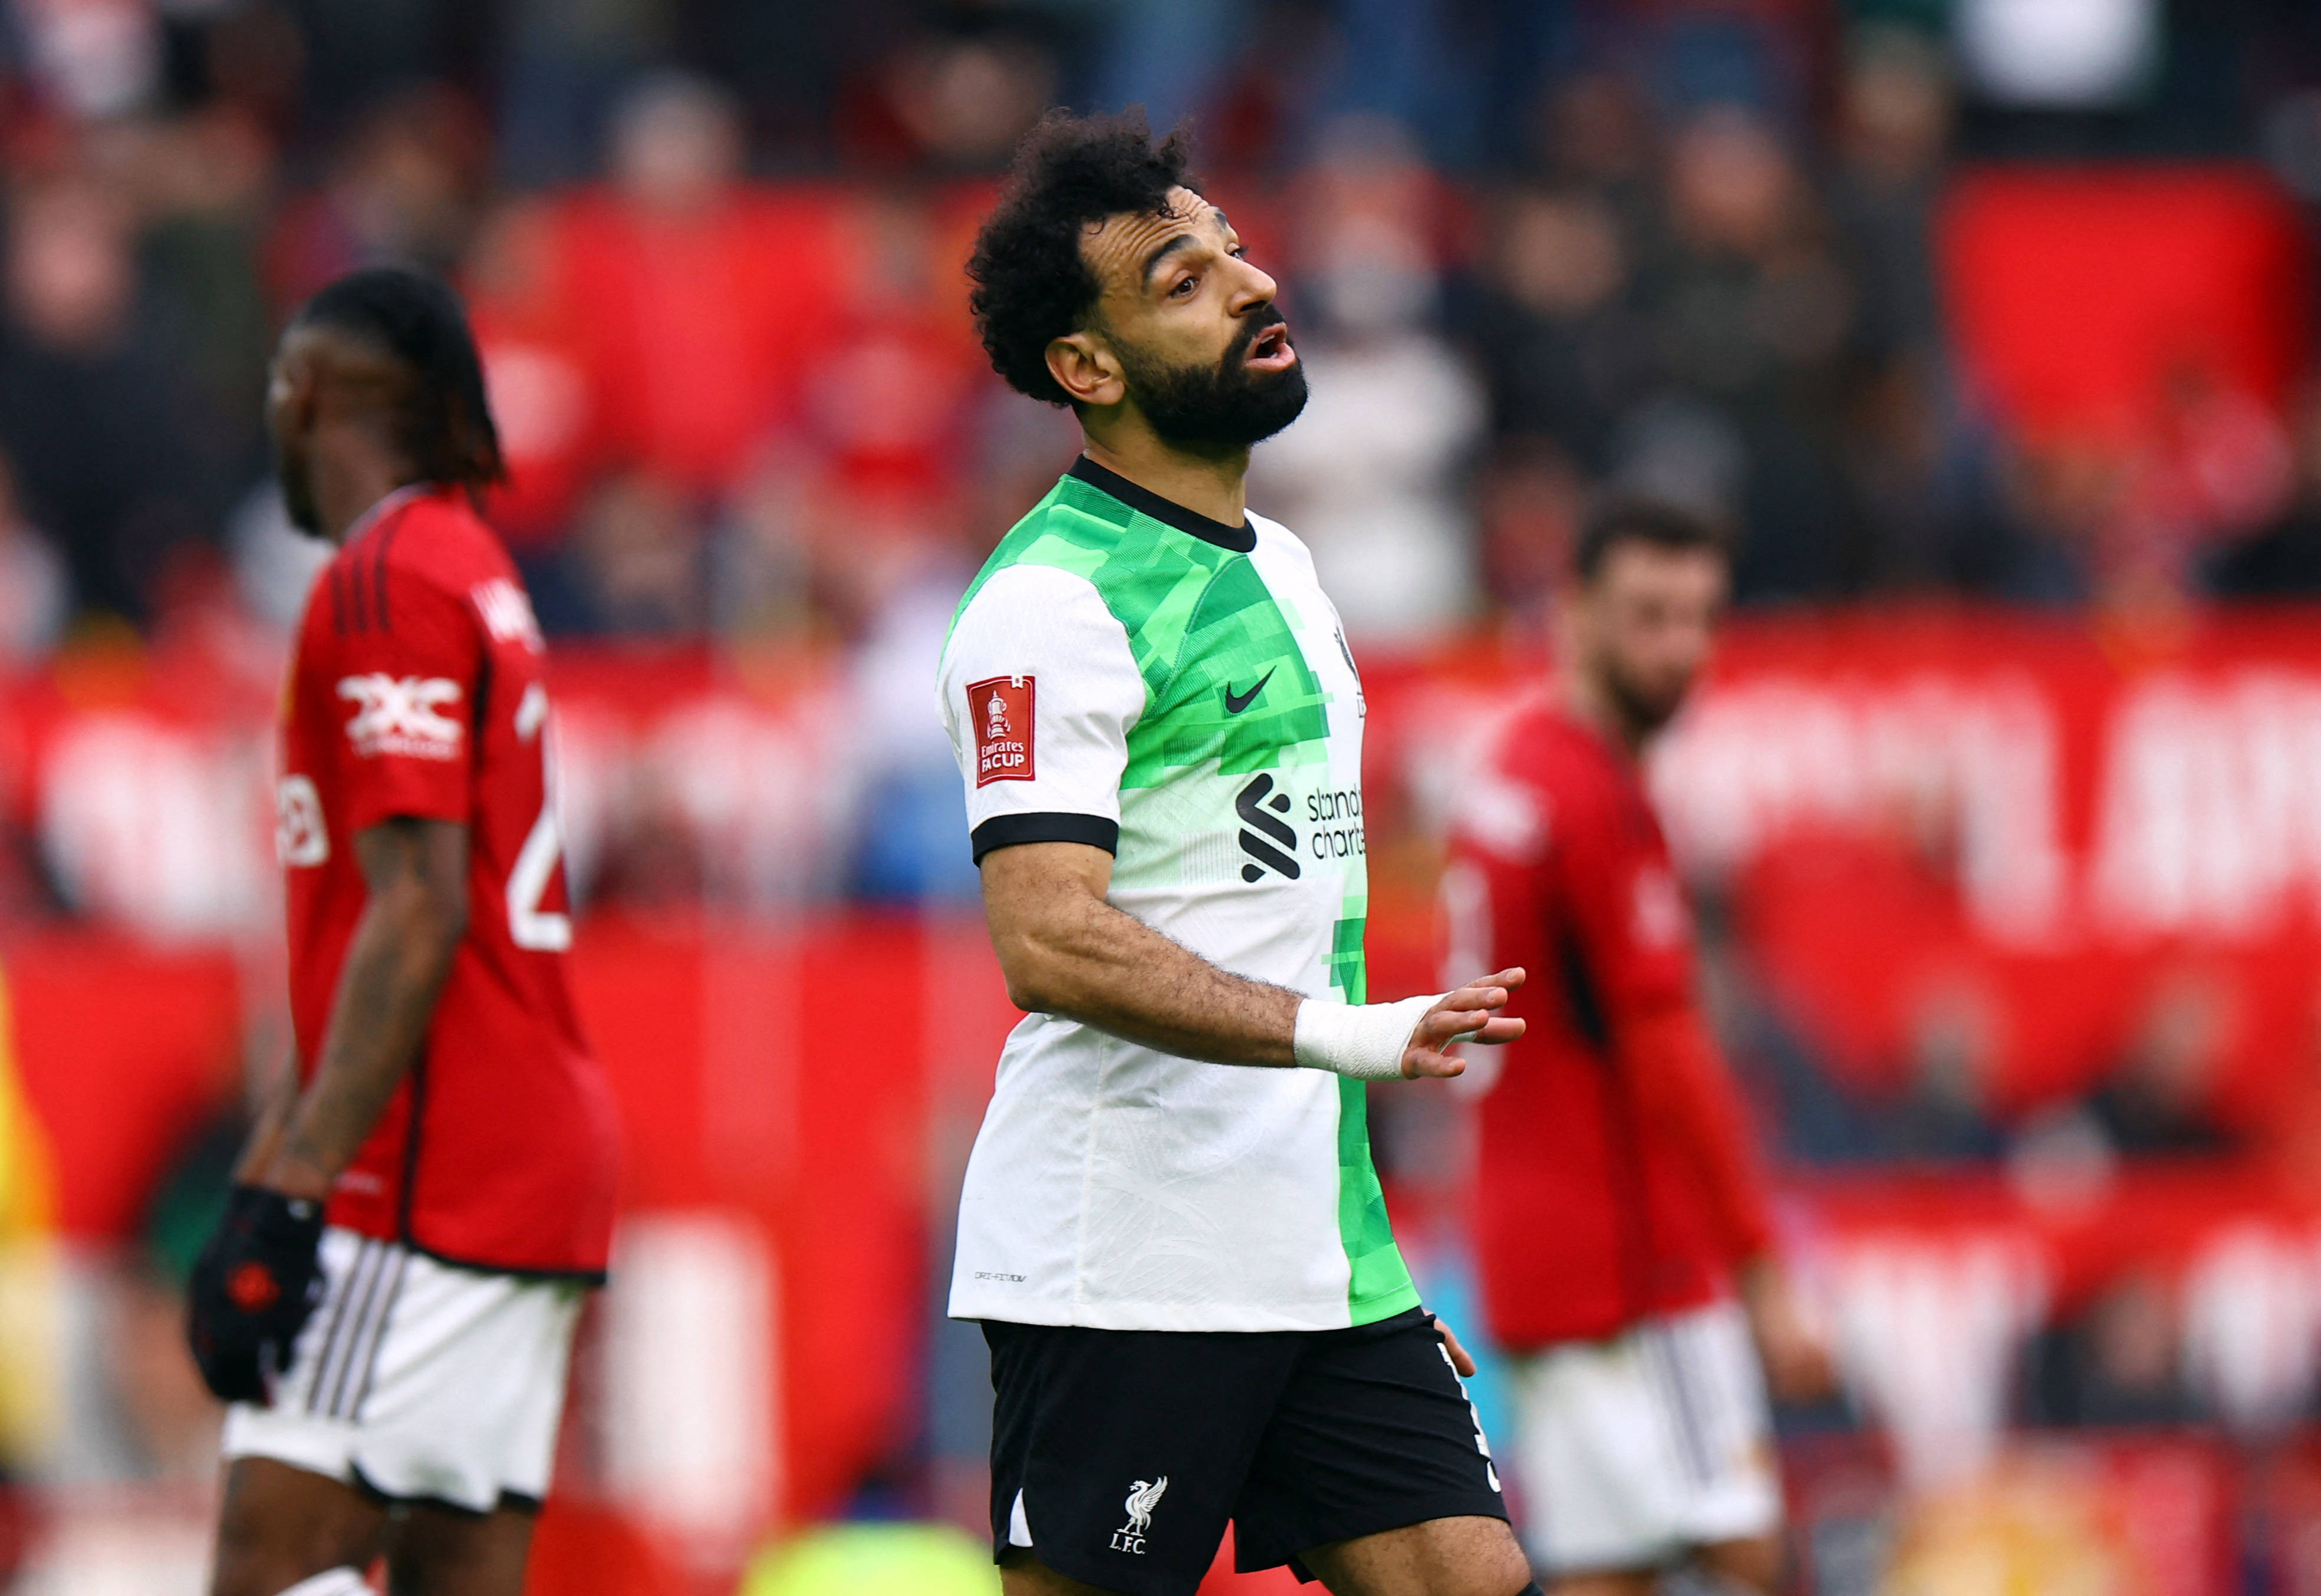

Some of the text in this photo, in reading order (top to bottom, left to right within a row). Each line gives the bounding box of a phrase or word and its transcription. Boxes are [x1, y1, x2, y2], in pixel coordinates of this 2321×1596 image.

[981, 741, 1025, 759] Emirates
[982, 753, 1025, 773] FA CUP
[1308, 783, 1362, 822] stand
